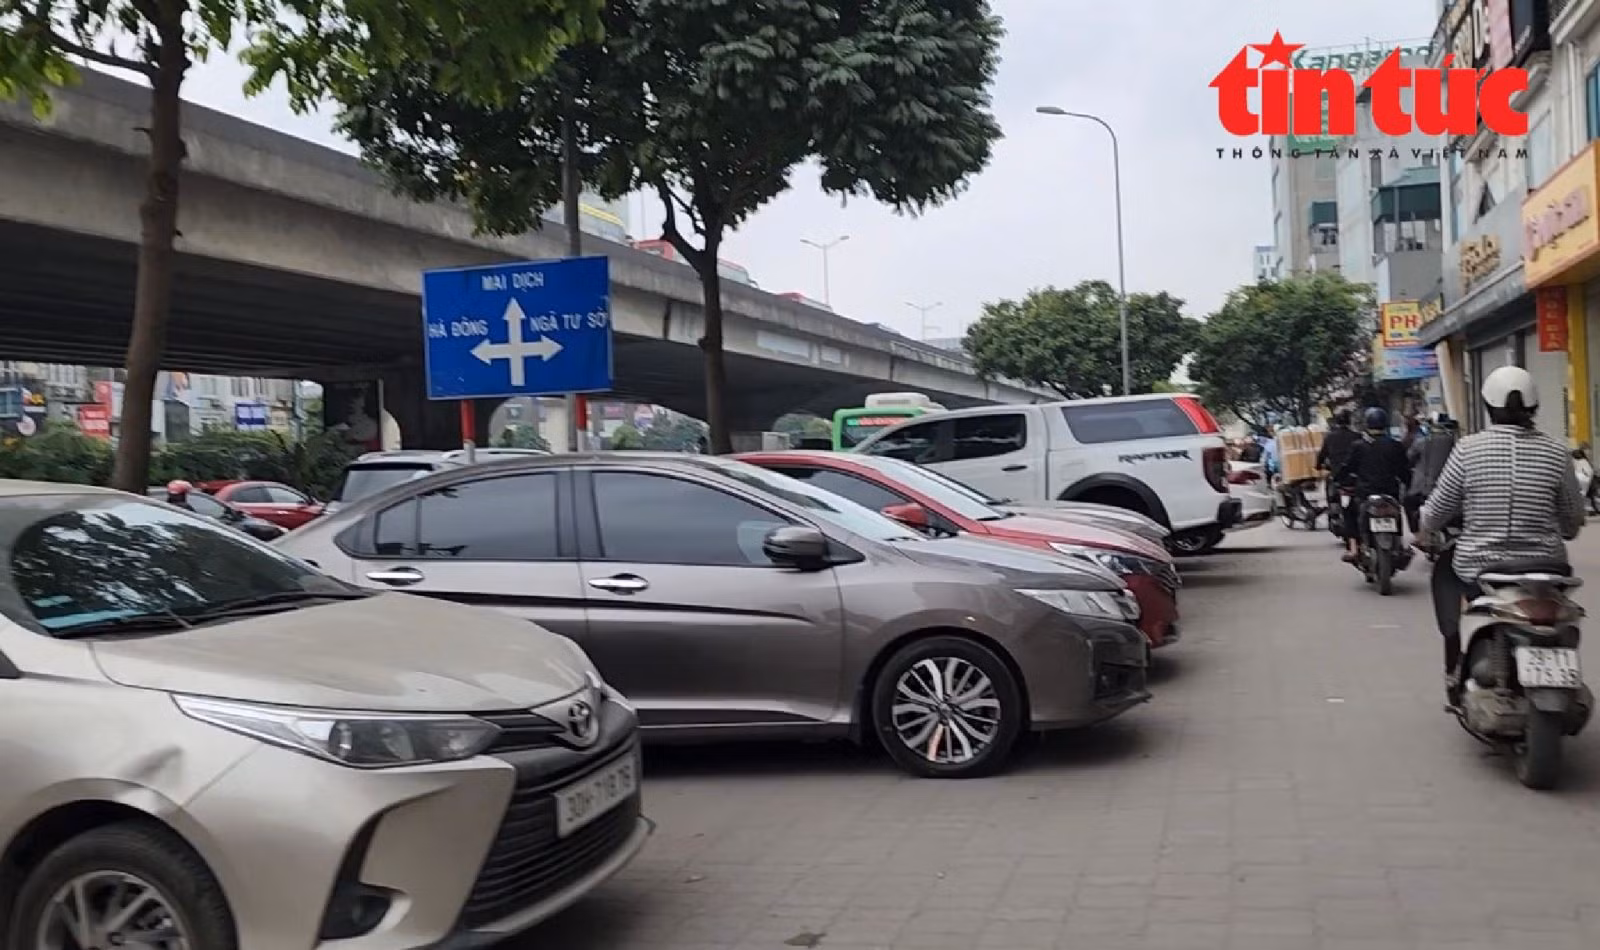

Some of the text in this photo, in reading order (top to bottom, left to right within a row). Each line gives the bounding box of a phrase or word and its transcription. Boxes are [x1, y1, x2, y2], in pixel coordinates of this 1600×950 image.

[481, 271, 545, 293] MAI DỊCH
[428, 318, 448, 338] HÀ
[1118, 449, 1193, 466] RAPTOR
